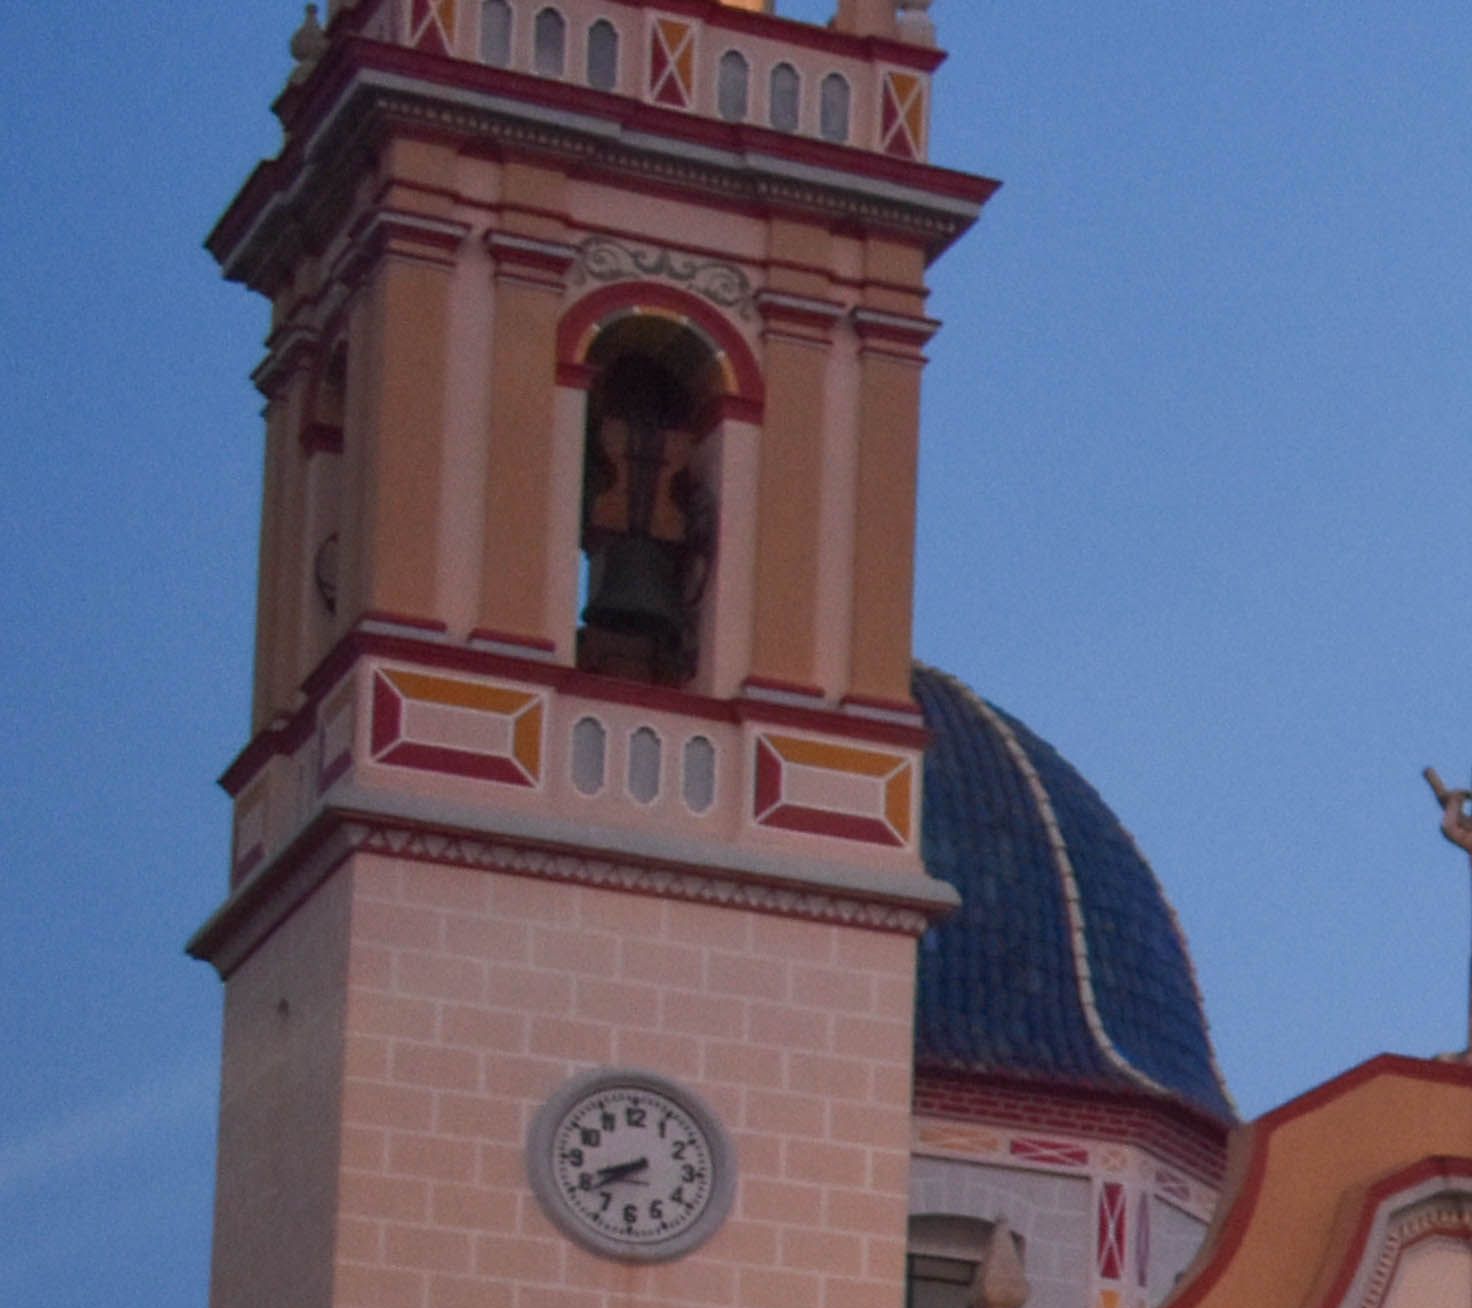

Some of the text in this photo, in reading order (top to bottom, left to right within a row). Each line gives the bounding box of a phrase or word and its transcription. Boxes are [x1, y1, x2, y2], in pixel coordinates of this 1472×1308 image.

[601, 1112, 616, 1132] 11
[625, 1107, 647, 1128] 12
[580, 1128, 601, 1148] 10
[658, 1120, 667, 1139] 1
[569, 1148, 583, 1168] 9
[672, 1141, 686, 1160] 2
[681, 1165, 695, 1184] 3
[600, 1192, 612, 1212] 7
[670, 1187, 685, 1205] 4
[623, 1203, 637, 1224] 6
[648, 1200, 663, 1220] 5
